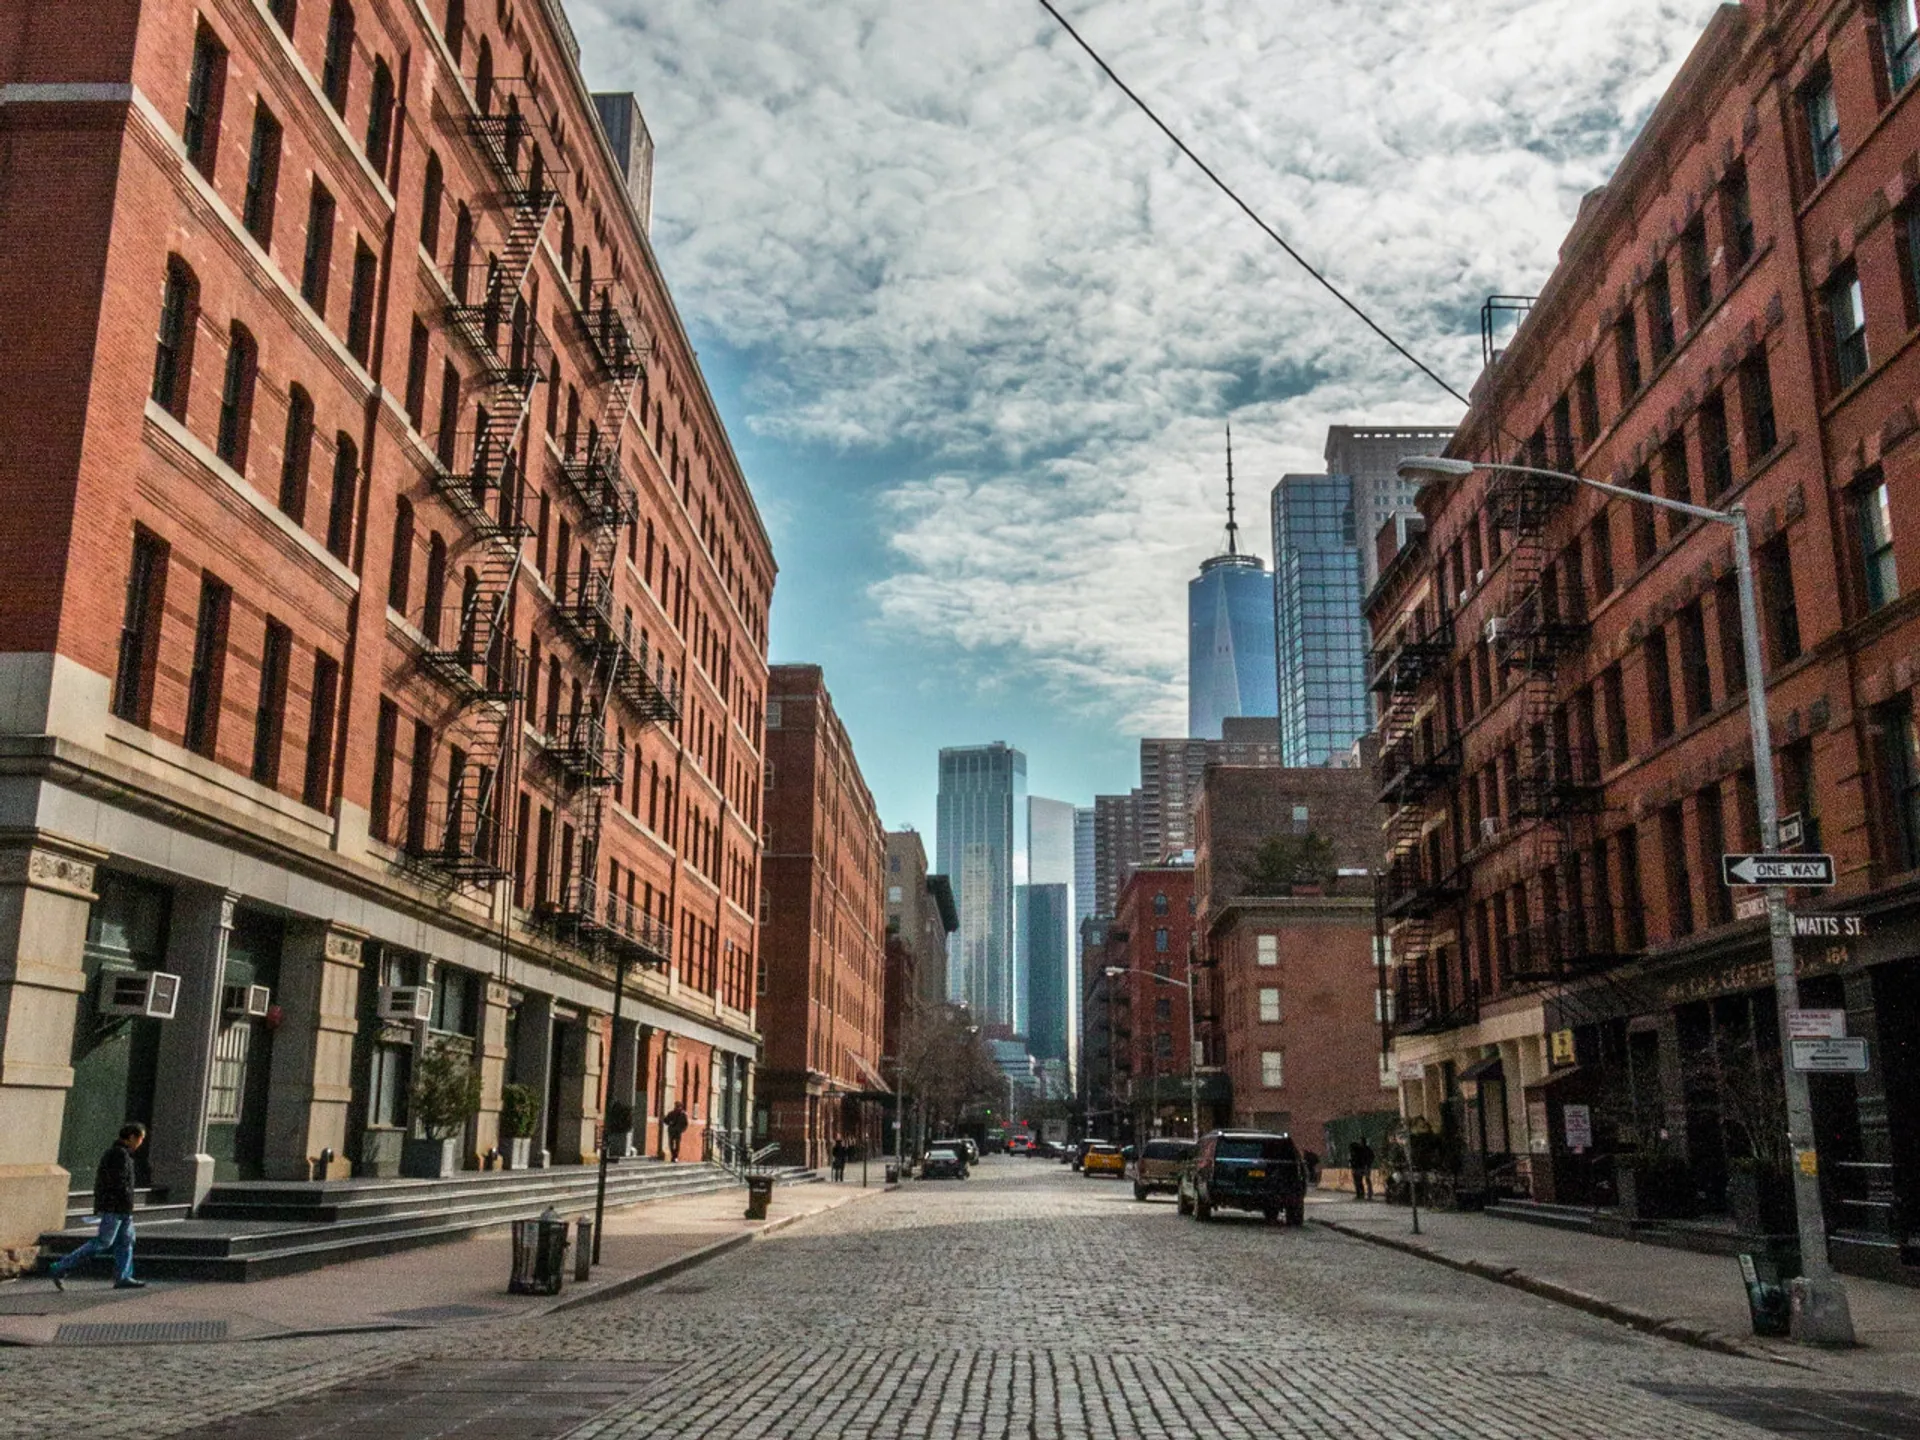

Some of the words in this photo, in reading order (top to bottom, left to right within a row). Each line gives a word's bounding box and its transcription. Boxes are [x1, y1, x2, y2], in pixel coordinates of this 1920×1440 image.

[1756, 863, 1787, 876] ONE
[1791, 863, 1821, 876] WAY
[1795, 916, 1839, 936] WATTS
[1843, 916, 1861, 936] ST
